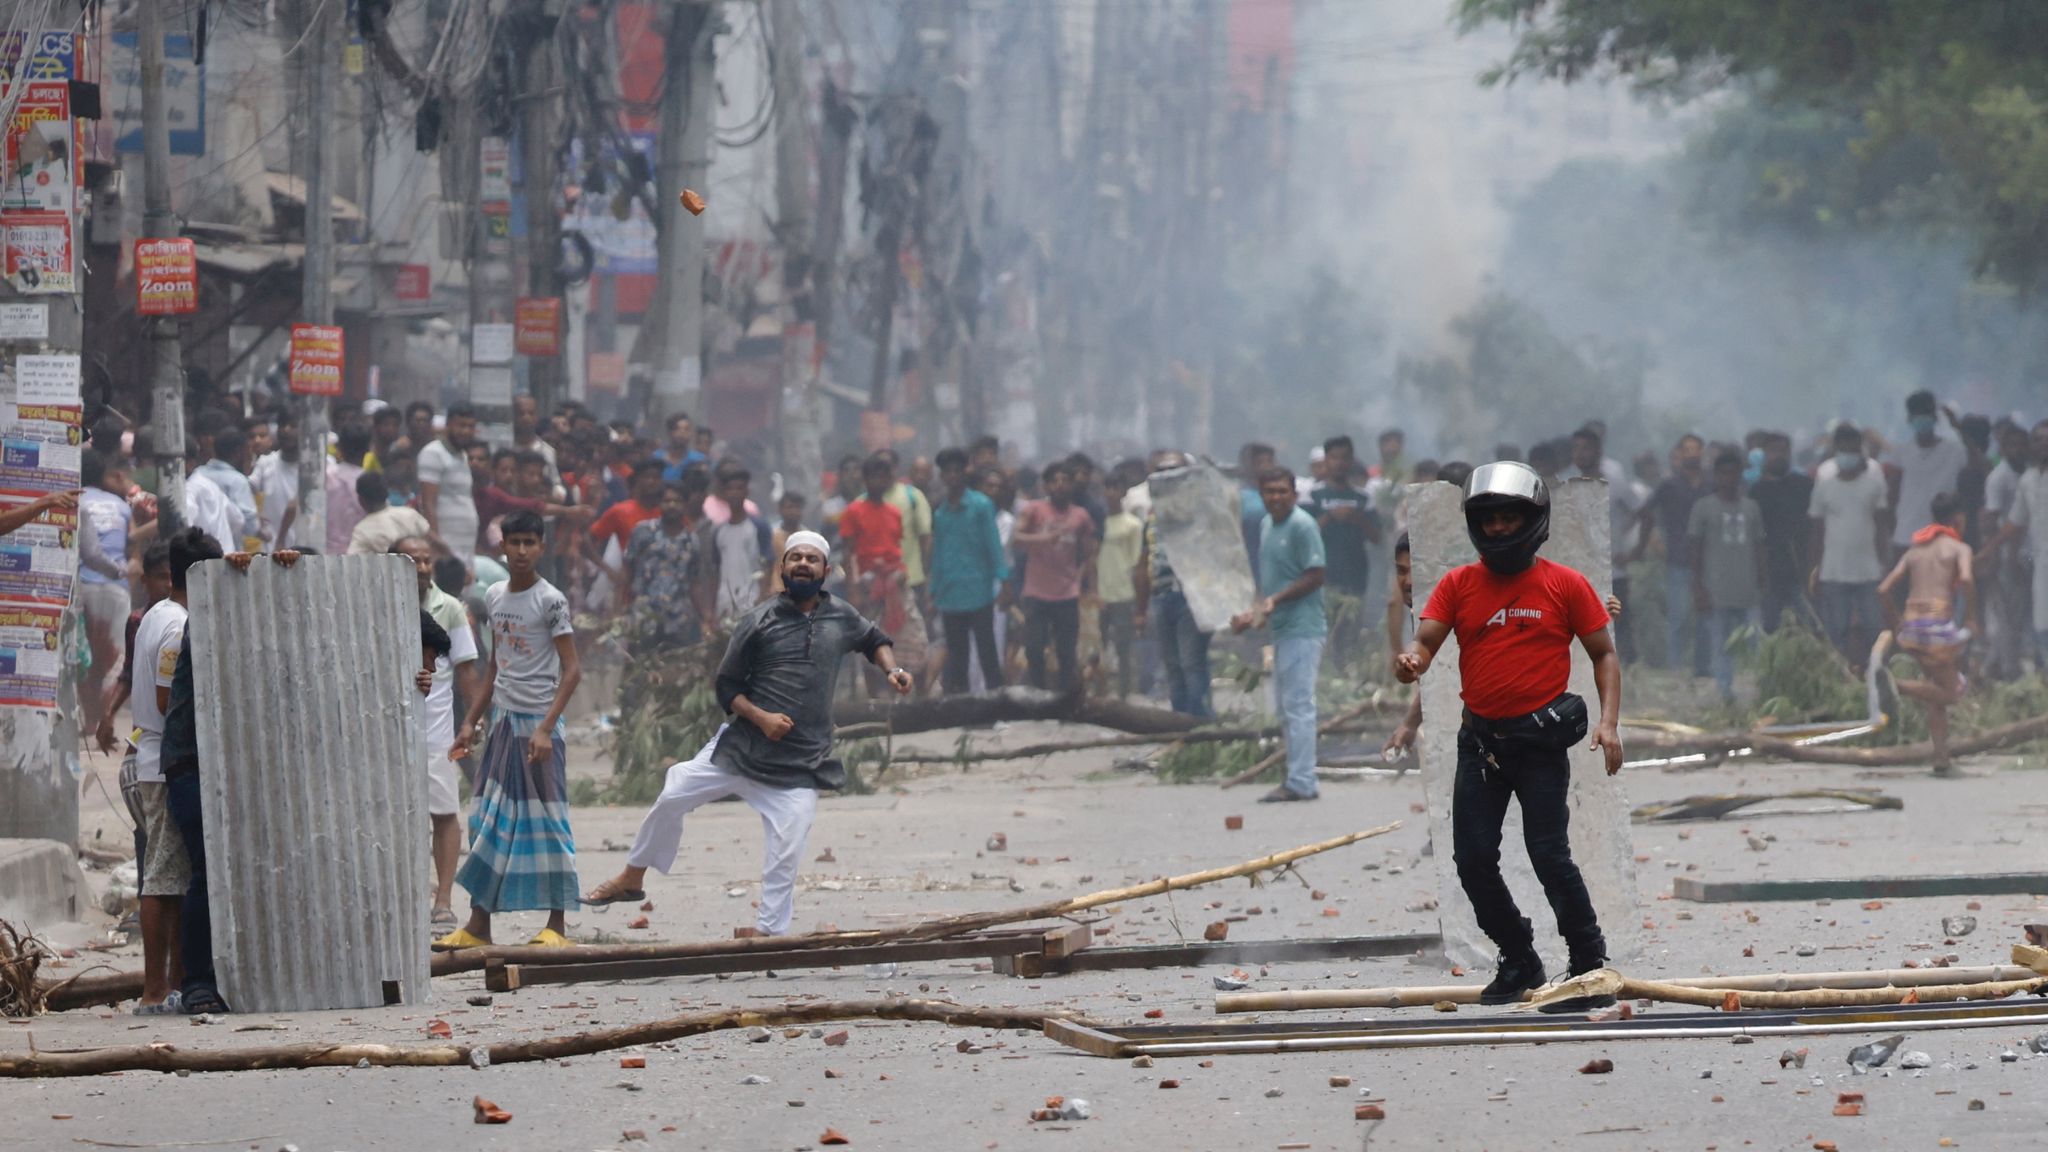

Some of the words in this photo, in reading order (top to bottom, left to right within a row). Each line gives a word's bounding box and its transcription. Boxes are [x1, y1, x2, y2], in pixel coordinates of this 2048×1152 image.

[141, 279, 192, 293] Zoom
[293, 360, 340, 375] Zoom
[1486, 608, 1506, 626] A
[1508, 608, 1542, 619] COMING
